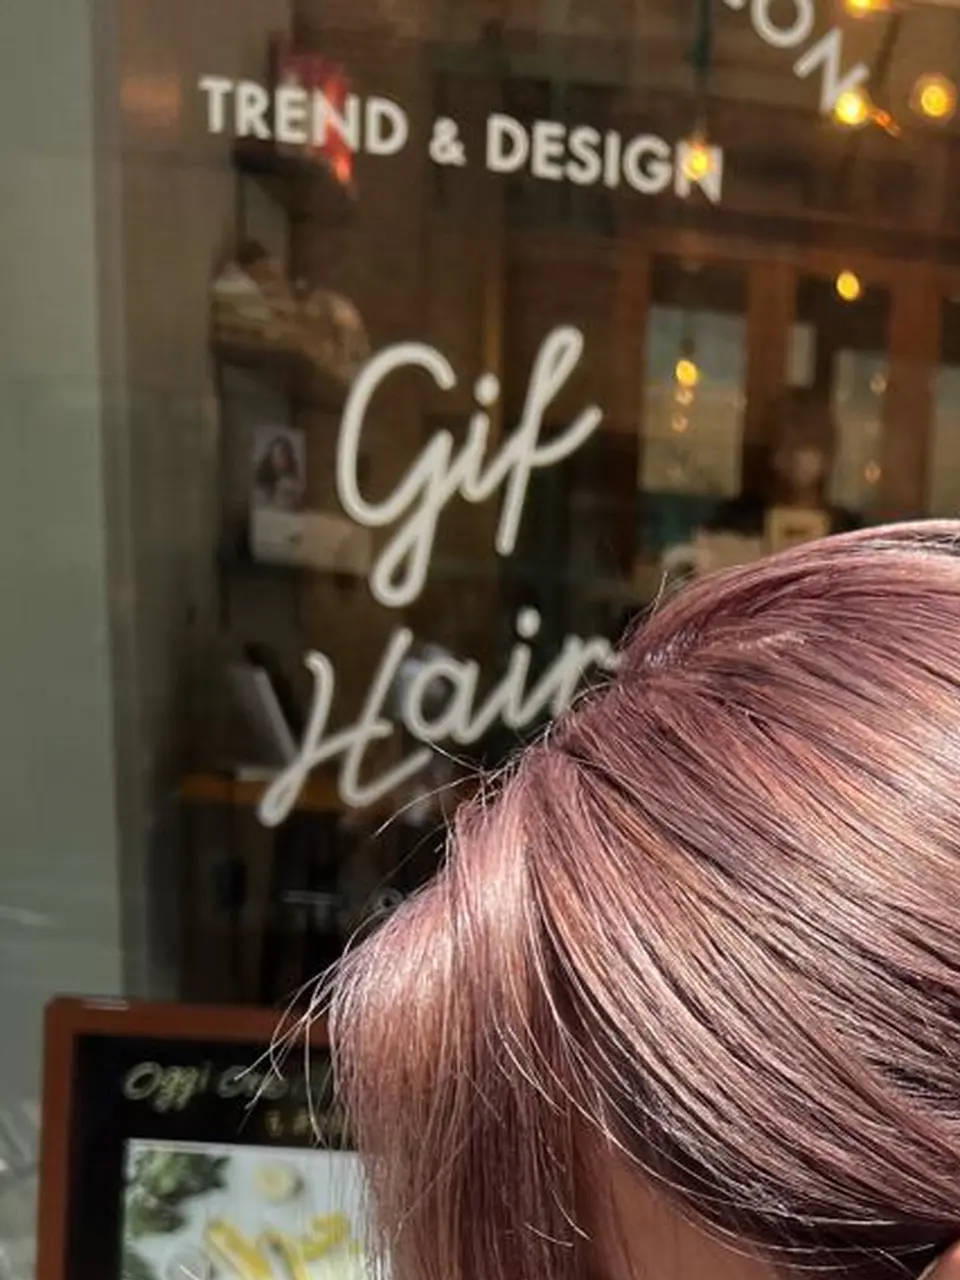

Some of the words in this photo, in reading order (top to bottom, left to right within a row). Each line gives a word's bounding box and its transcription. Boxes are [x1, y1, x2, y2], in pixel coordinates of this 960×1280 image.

[200, 77, 408, 156] TREND
[429, 116, 467, 167] &
[486, 113, 723, 204] DESIGN
[723, 0, 869, 114] ON
[337, 326, 602, 606] Gif
[256, 608, 622, 828] Hair
